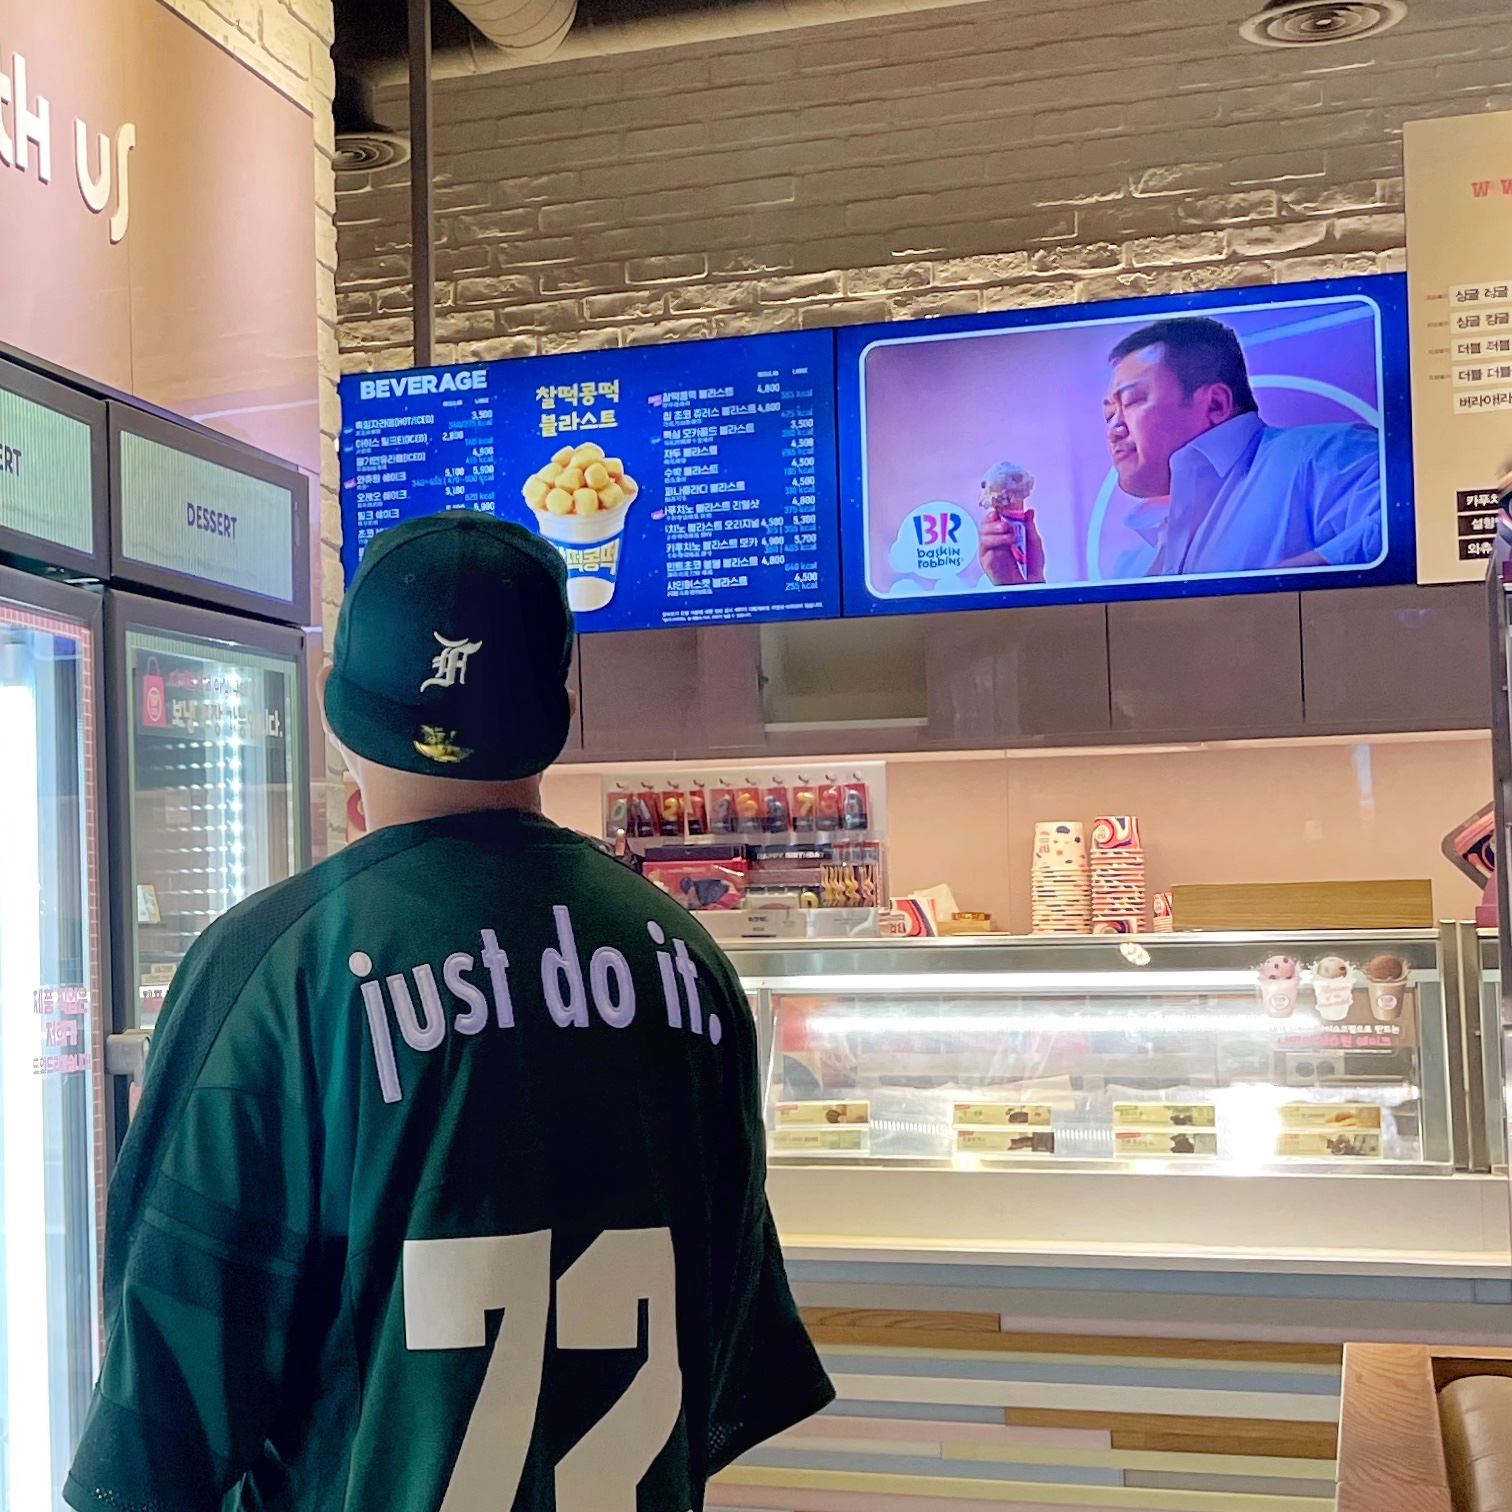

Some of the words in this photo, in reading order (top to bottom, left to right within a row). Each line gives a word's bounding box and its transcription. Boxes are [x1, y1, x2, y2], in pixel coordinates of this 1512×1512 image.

[1456, 288, 1479, 302] 싱글
[1457, 315, 1480, 329] 싱글
[1458, 342, 1481, 355] 더블
[360, 369, 487, 400] BEVERAGE
[1458, 369, 1482, 382] 더블
[536, 379, 619, 409] 찰떡콩떡
[538, 409, 618, 437] 블라스트
[186, 502, 237, 540] DESSERT
[913, 512, 962, 545] BR
[917, 545, 960, 558] baskin
[917, 557, 961, 569] robbins
[349, 929, 515, 1105] just
[541, 905, 637, 1029] do
[647, 921, 723, 1046] it.
